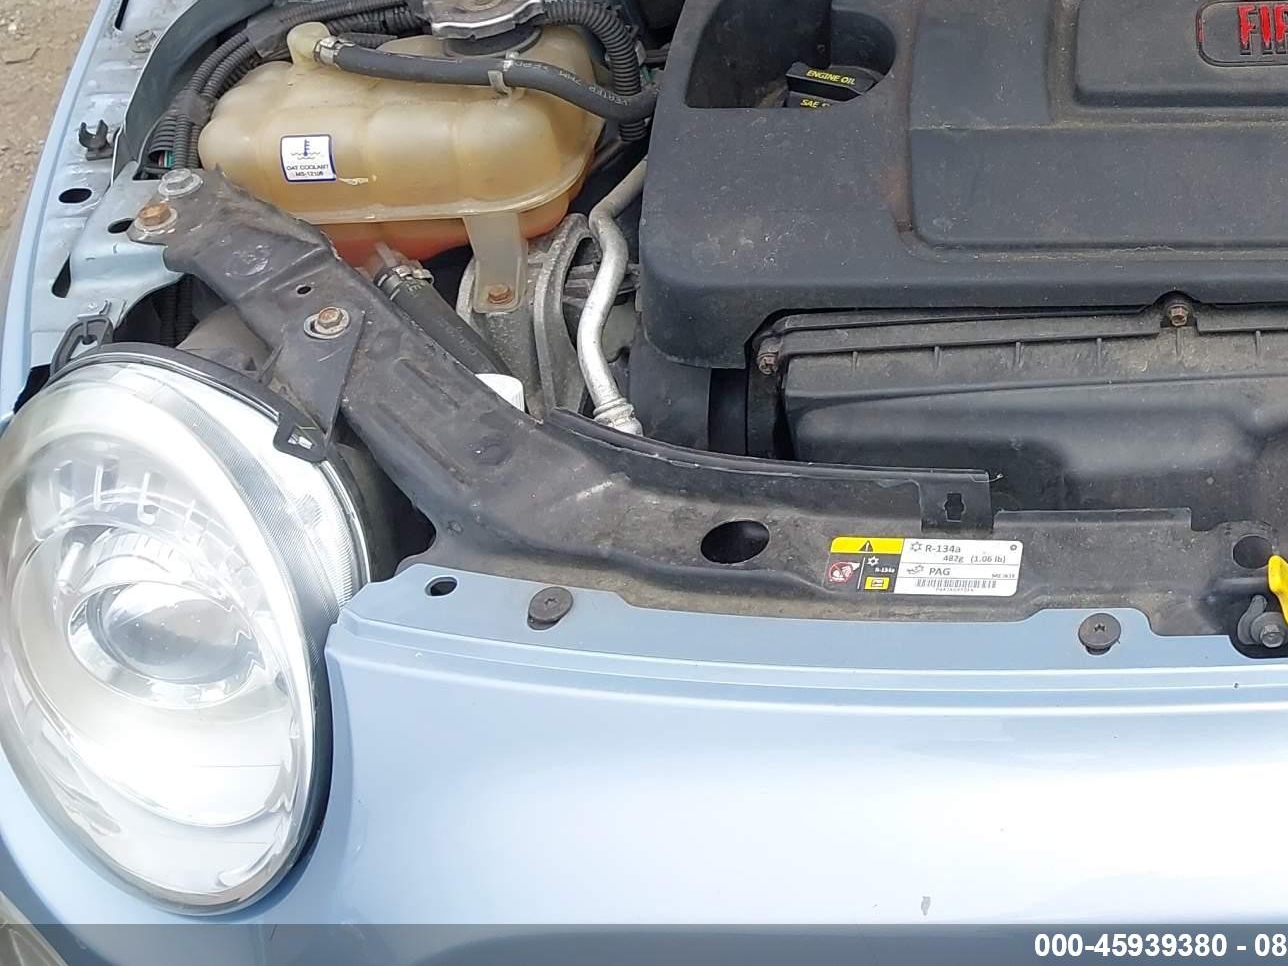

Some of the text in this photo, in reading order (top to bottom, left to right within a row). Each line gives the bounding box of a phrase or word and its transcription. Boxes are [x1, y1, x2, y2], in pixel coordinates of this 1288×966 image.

[805, 69, 856, 86] ENGINE OIL
[800, 98, 819, 109] SAE
[925, 544, 961, 553] R-134a
[943, 554, 964, 563] 482g
[929, 567, 951, 576] PAG
